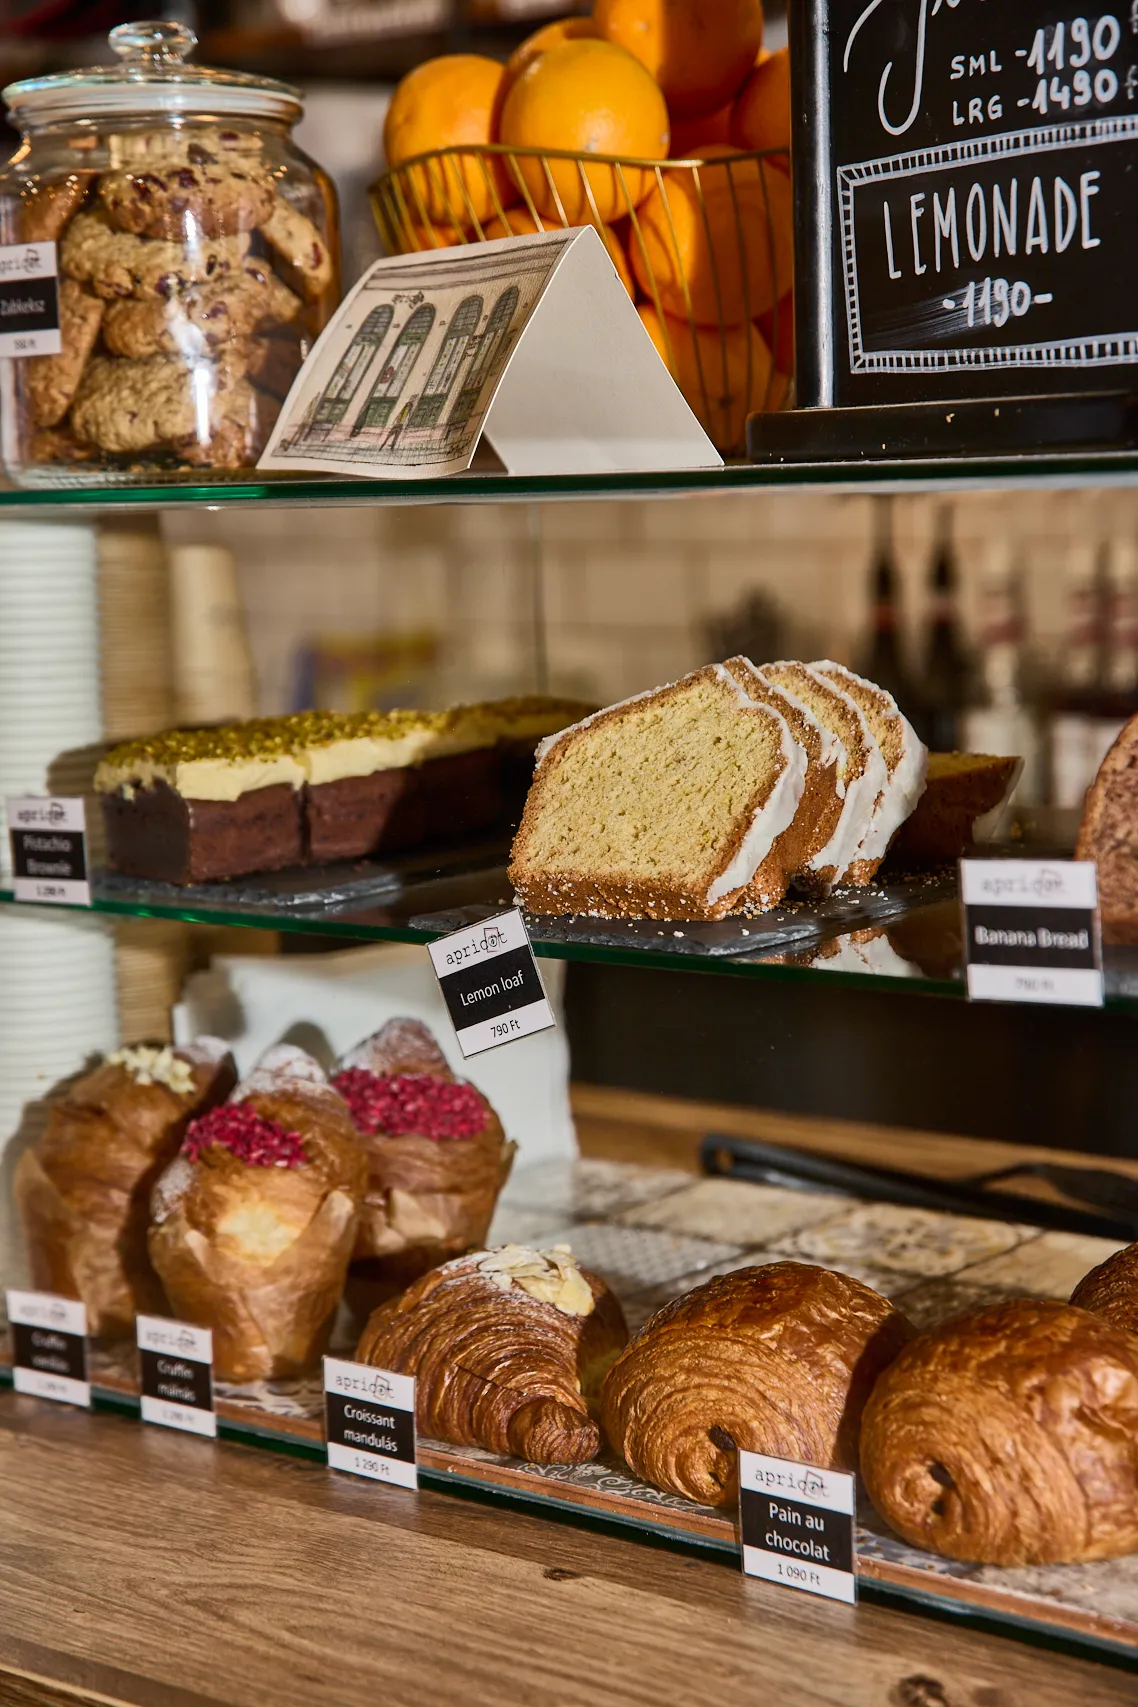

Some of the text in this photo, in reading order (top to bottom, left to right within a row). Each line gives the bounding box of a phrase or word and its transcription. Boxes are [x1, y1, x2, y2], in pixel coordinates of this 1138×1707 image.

[950, 50, 1002, 79] SML
[952, 95, 1003, 126] LRG
[884, 171, 1101, 279] LEMONADE
[446, 929, 508, 965] apricot
[974, 925, 1089, 949] Banana Bread
[460, 969, 524, 1006] Lemon loaf
[490, 1019, 521, 1038] 790 Ft
[336, 1375, 395, 1399] apricot
[344, 1404, 396, 1429] Croissant
[344, 1429, 398, 1452] mandulás
[381, 1463, 390, 1475] Ft
[755, 1468, 831, 1498] apricot
[769, 1502, 825, 1532] Pain au
[765, 1530, 830, 1562] chocolat
[810, 1572, 821, 1586] Ft
